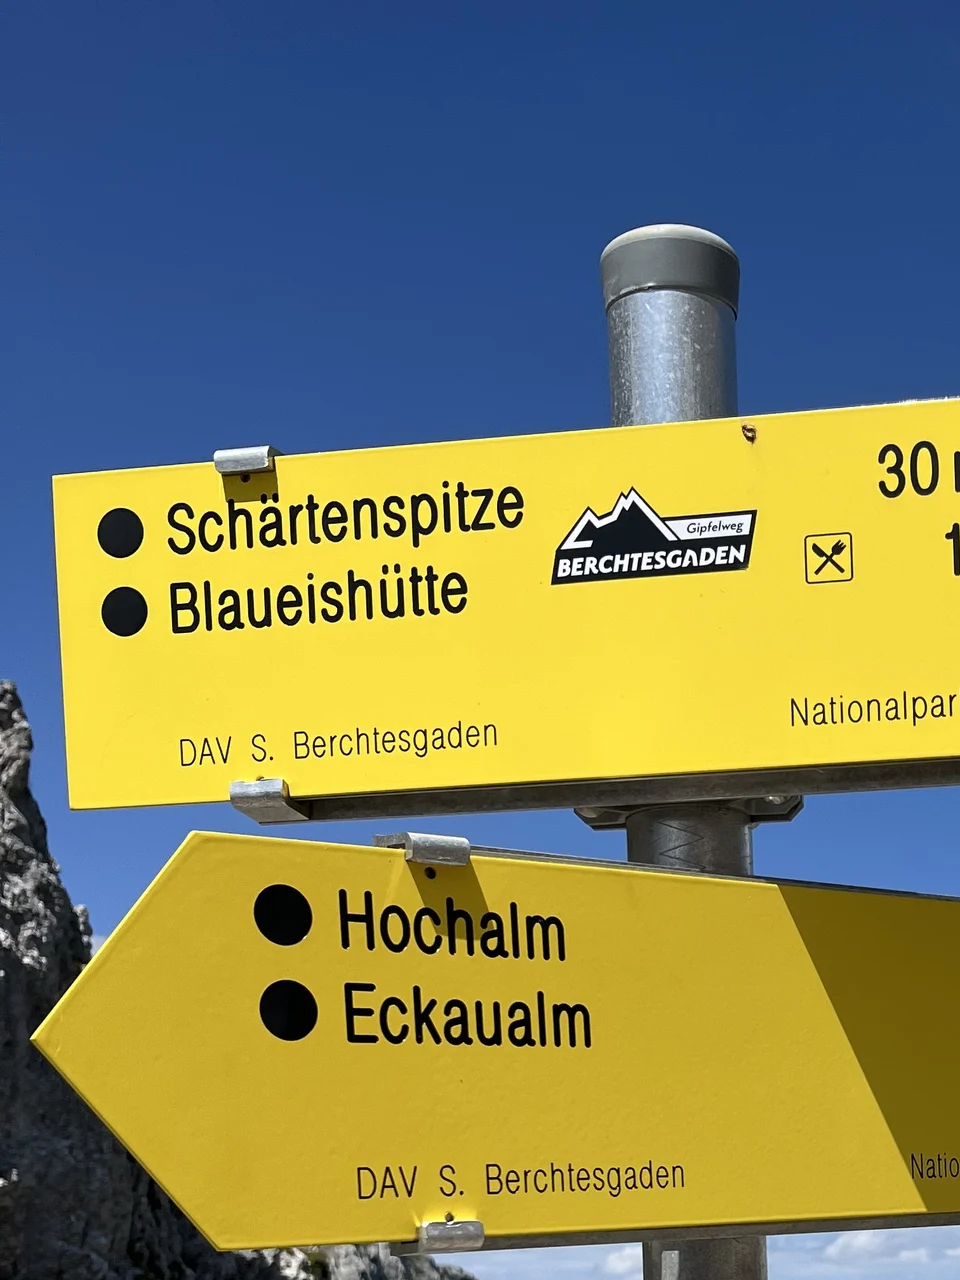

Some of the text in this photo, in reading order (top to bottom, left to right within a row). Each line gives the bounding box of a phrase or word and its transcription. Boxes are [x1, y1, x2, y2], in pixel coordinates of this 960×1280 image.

[878, 440, 938, 498] 30
[167, 481, 524, 555] Schärtenspitze
[687, 521, 744, 535] Gipfelweg
[557, 544, 746, 577] BERCHTESGADEN
[171, 564, 468, 634] Blaueishütte
[180, 720, 497, 767] DAV S. Berchtesgaden
[338, 889, 566, 961] Hochalm
[344, 982, 591, 1048] Eckaualm
[356, 1161, 684, 1199] DAV S. Berchtesgaden
